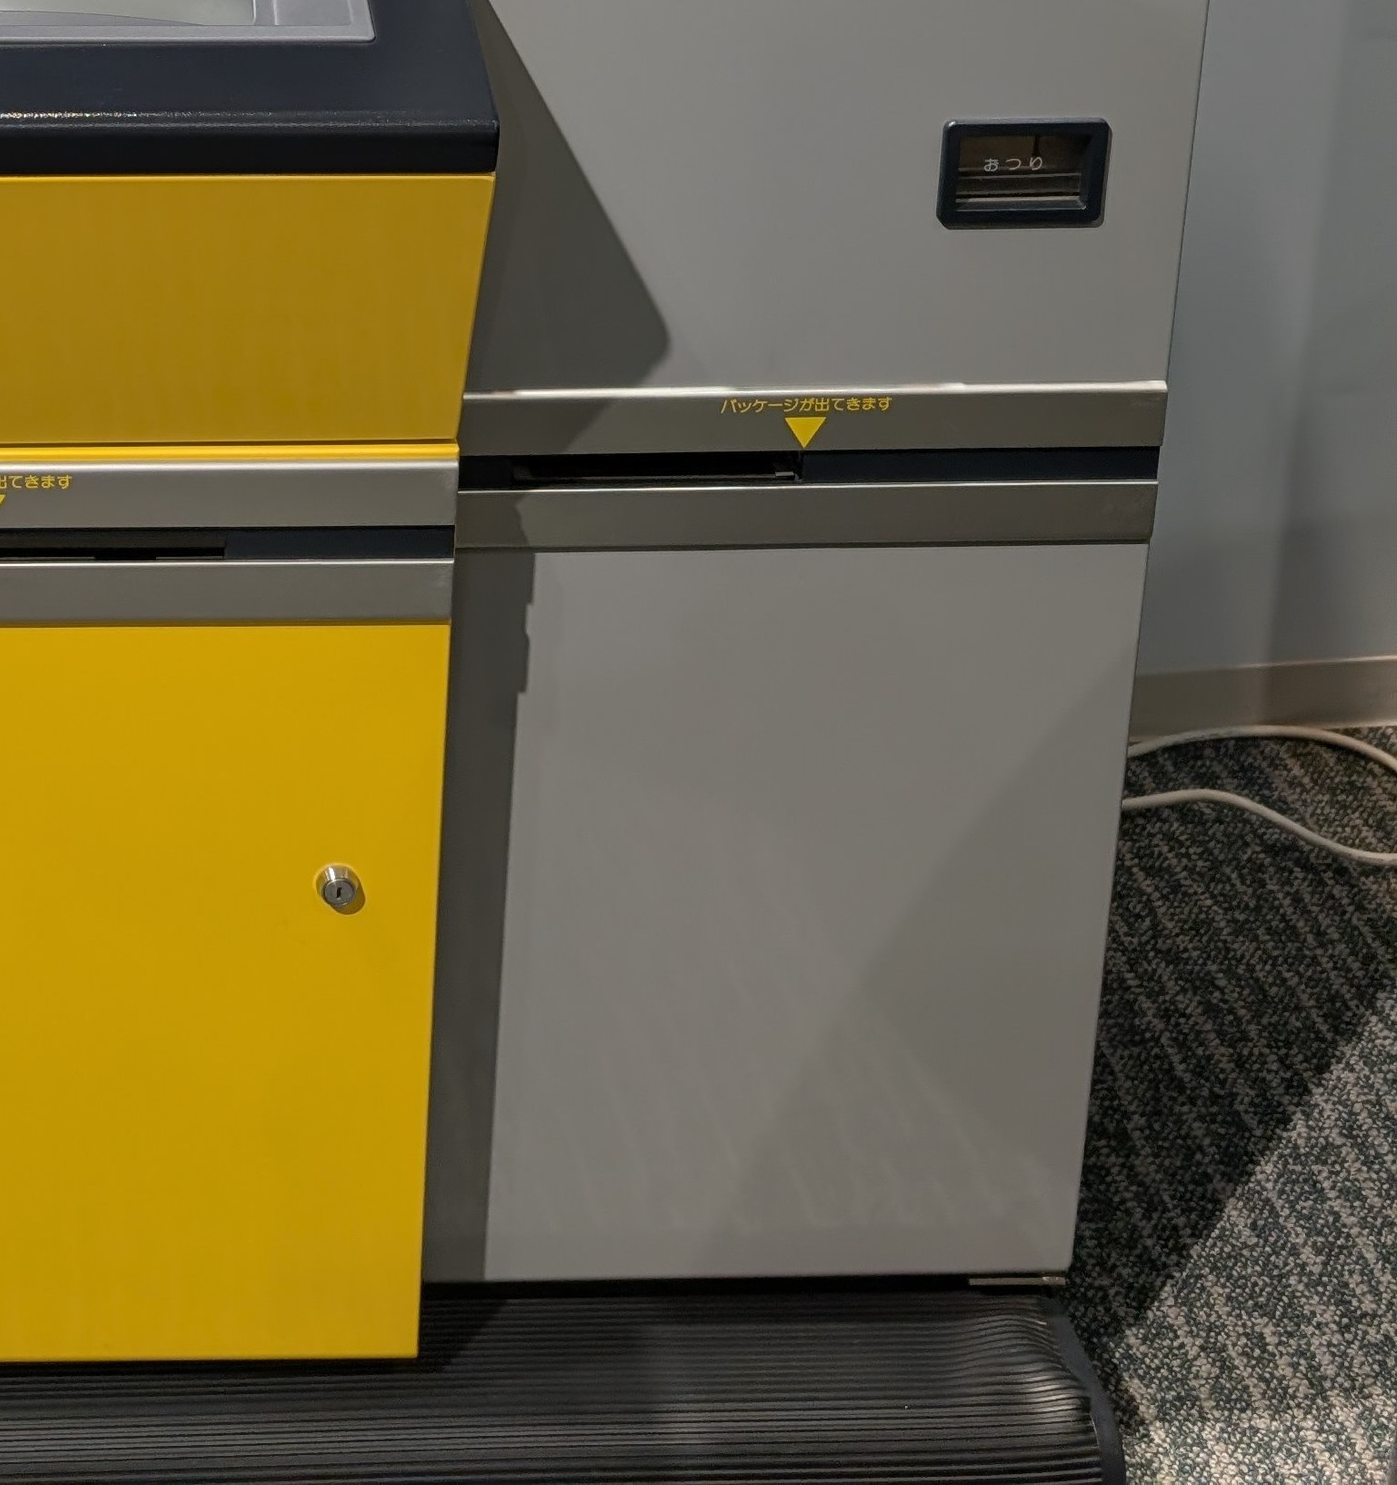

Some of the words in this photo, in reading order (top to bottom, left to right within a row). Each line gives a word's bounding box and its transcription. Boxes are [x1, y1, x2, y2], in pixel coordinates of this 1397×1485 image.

[983, 156, 1044, 172] おつり
[720, 396, 893, 415] パッケージが出てきます
